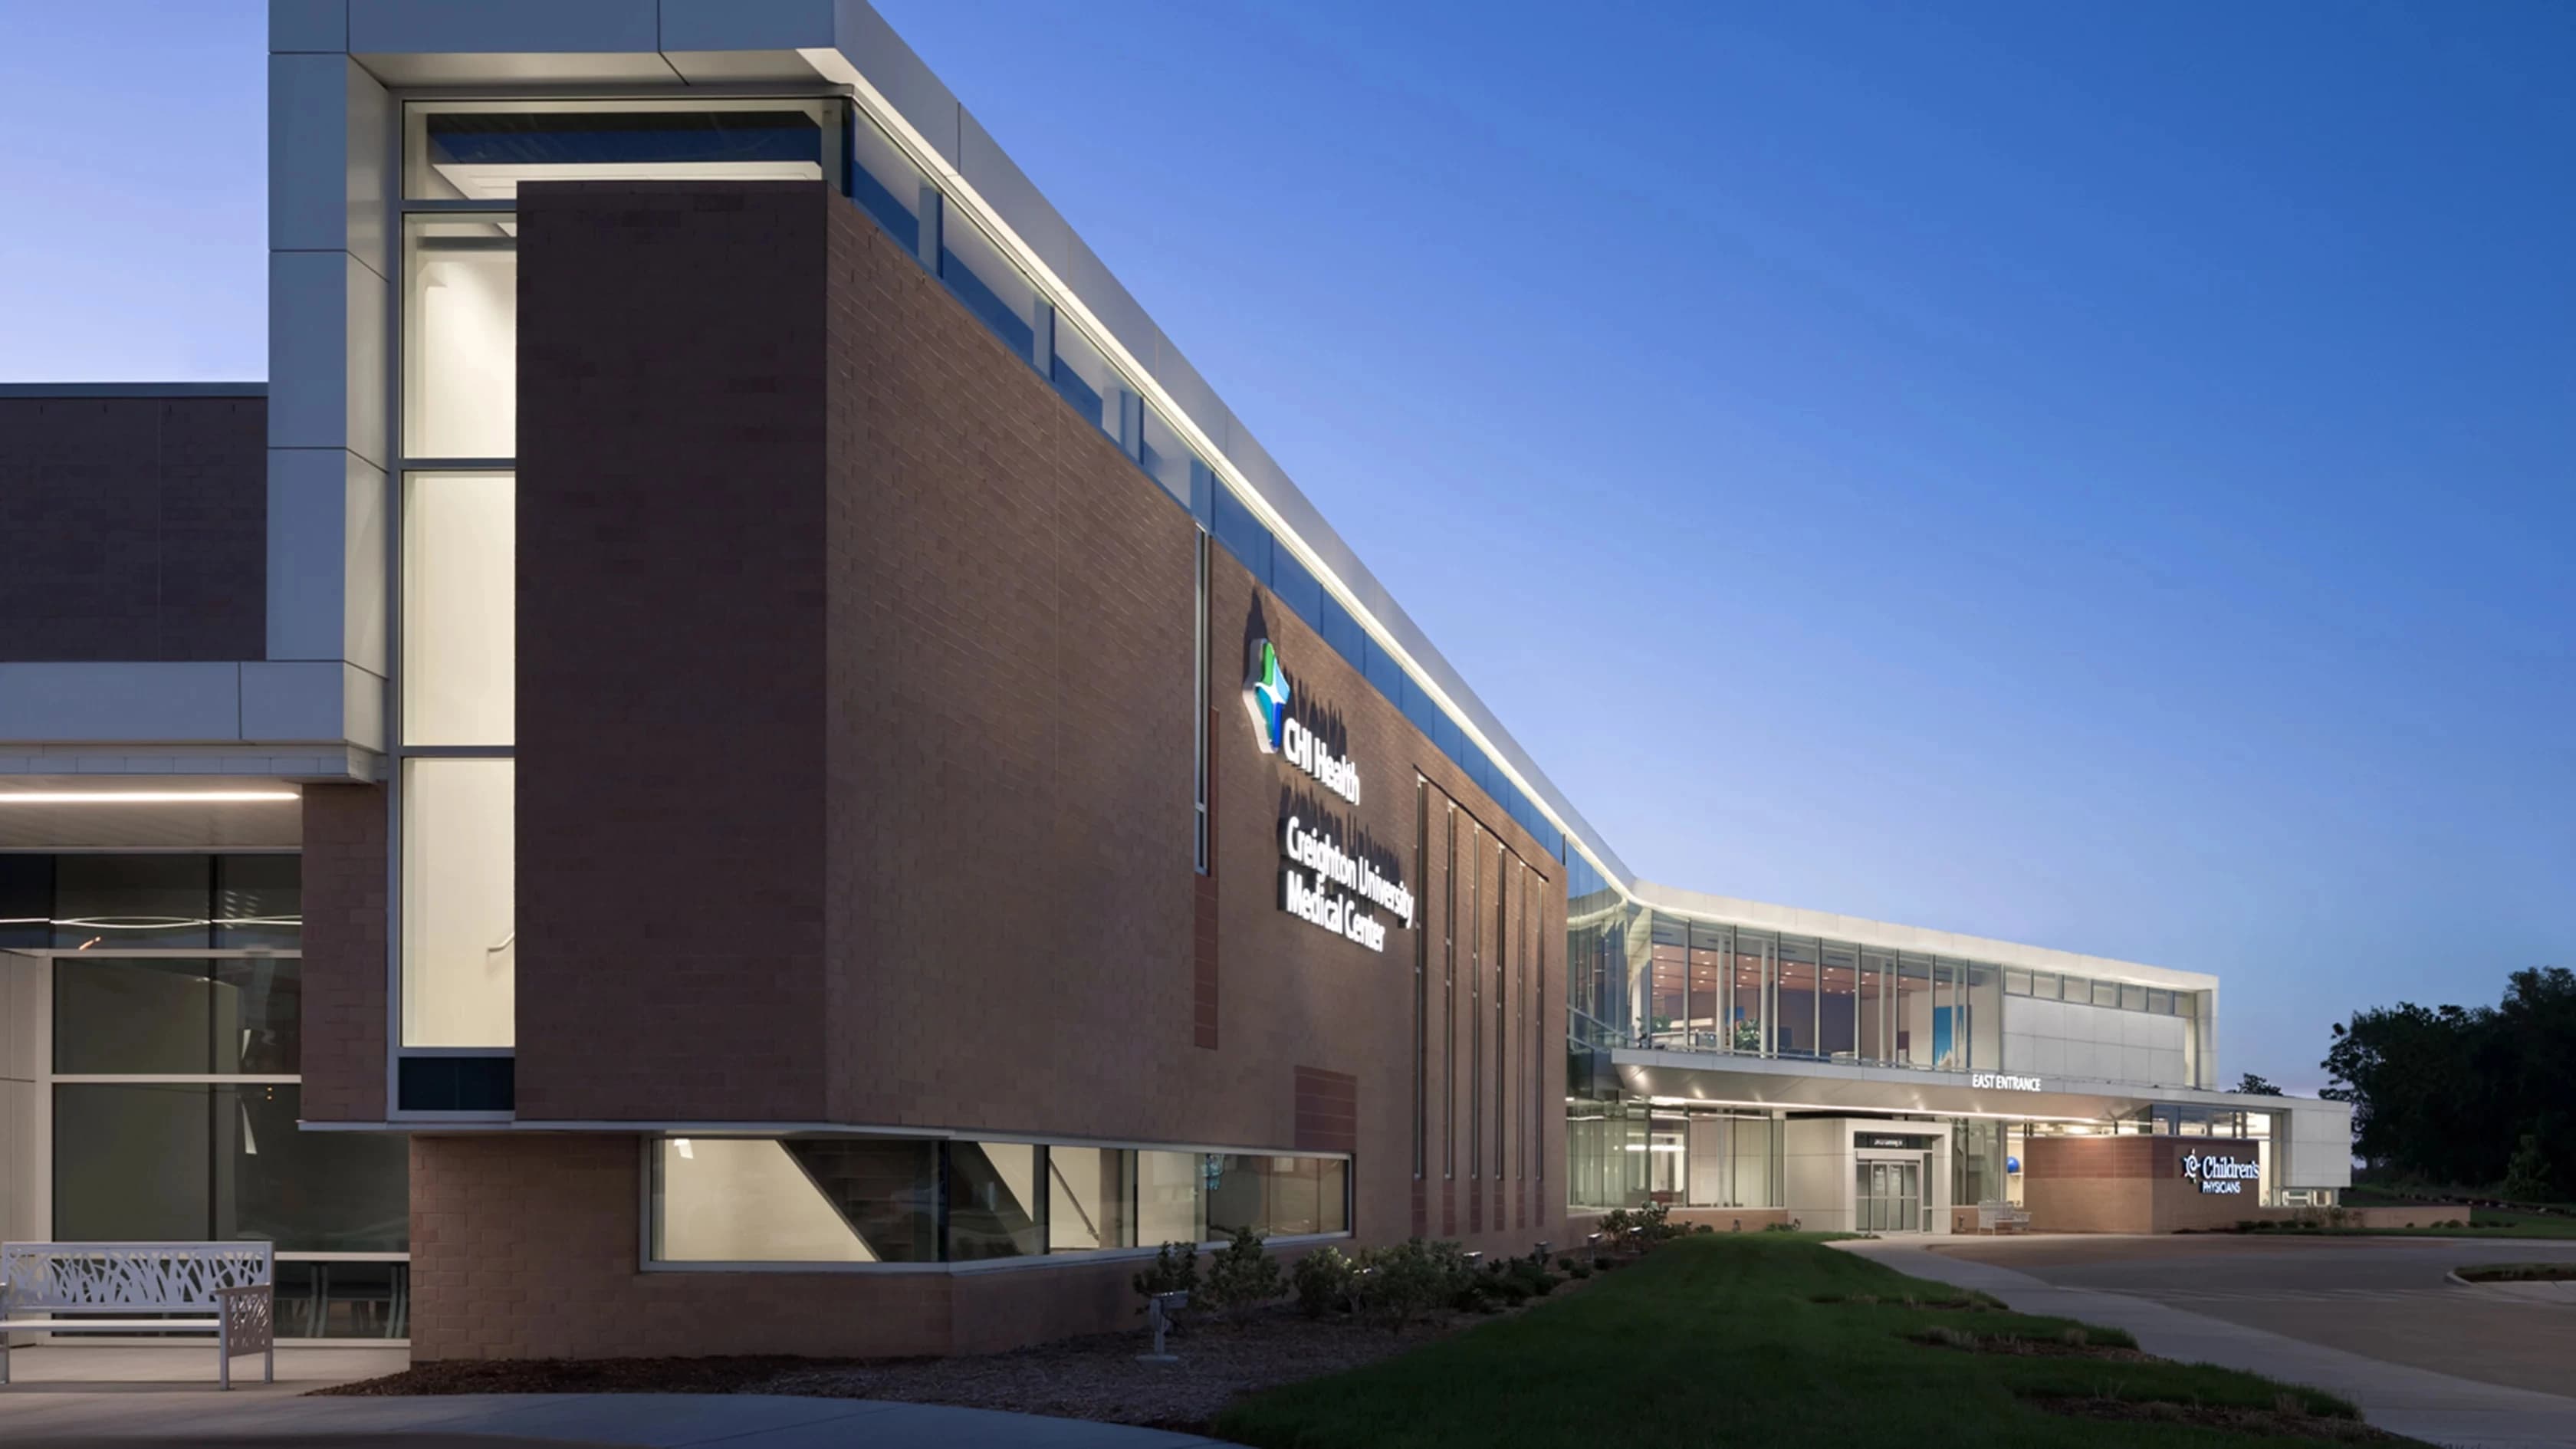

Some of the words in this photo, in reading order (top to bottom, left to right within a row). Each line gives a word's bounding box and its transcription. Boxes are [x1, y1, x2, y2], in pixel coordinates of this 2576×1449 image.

[1283, 717, 1312, 772] CHI
[1314, 737, 1360, 806] Health
[1286, 816, 1356, 890] Creighton
[1359, 856, 1414, 929] University
[1286, 870, 1342, 934] Medical
[1345, 900, 1385, 952] Center
[1973, 1073, 1994, 1089] EAST
[1996, 1075, 2042, 1092] ENTRANCE
[2203, 1155, 2260, 1179] Children's
[2203, 1181, 2241, 1194] PHYSICIANS
